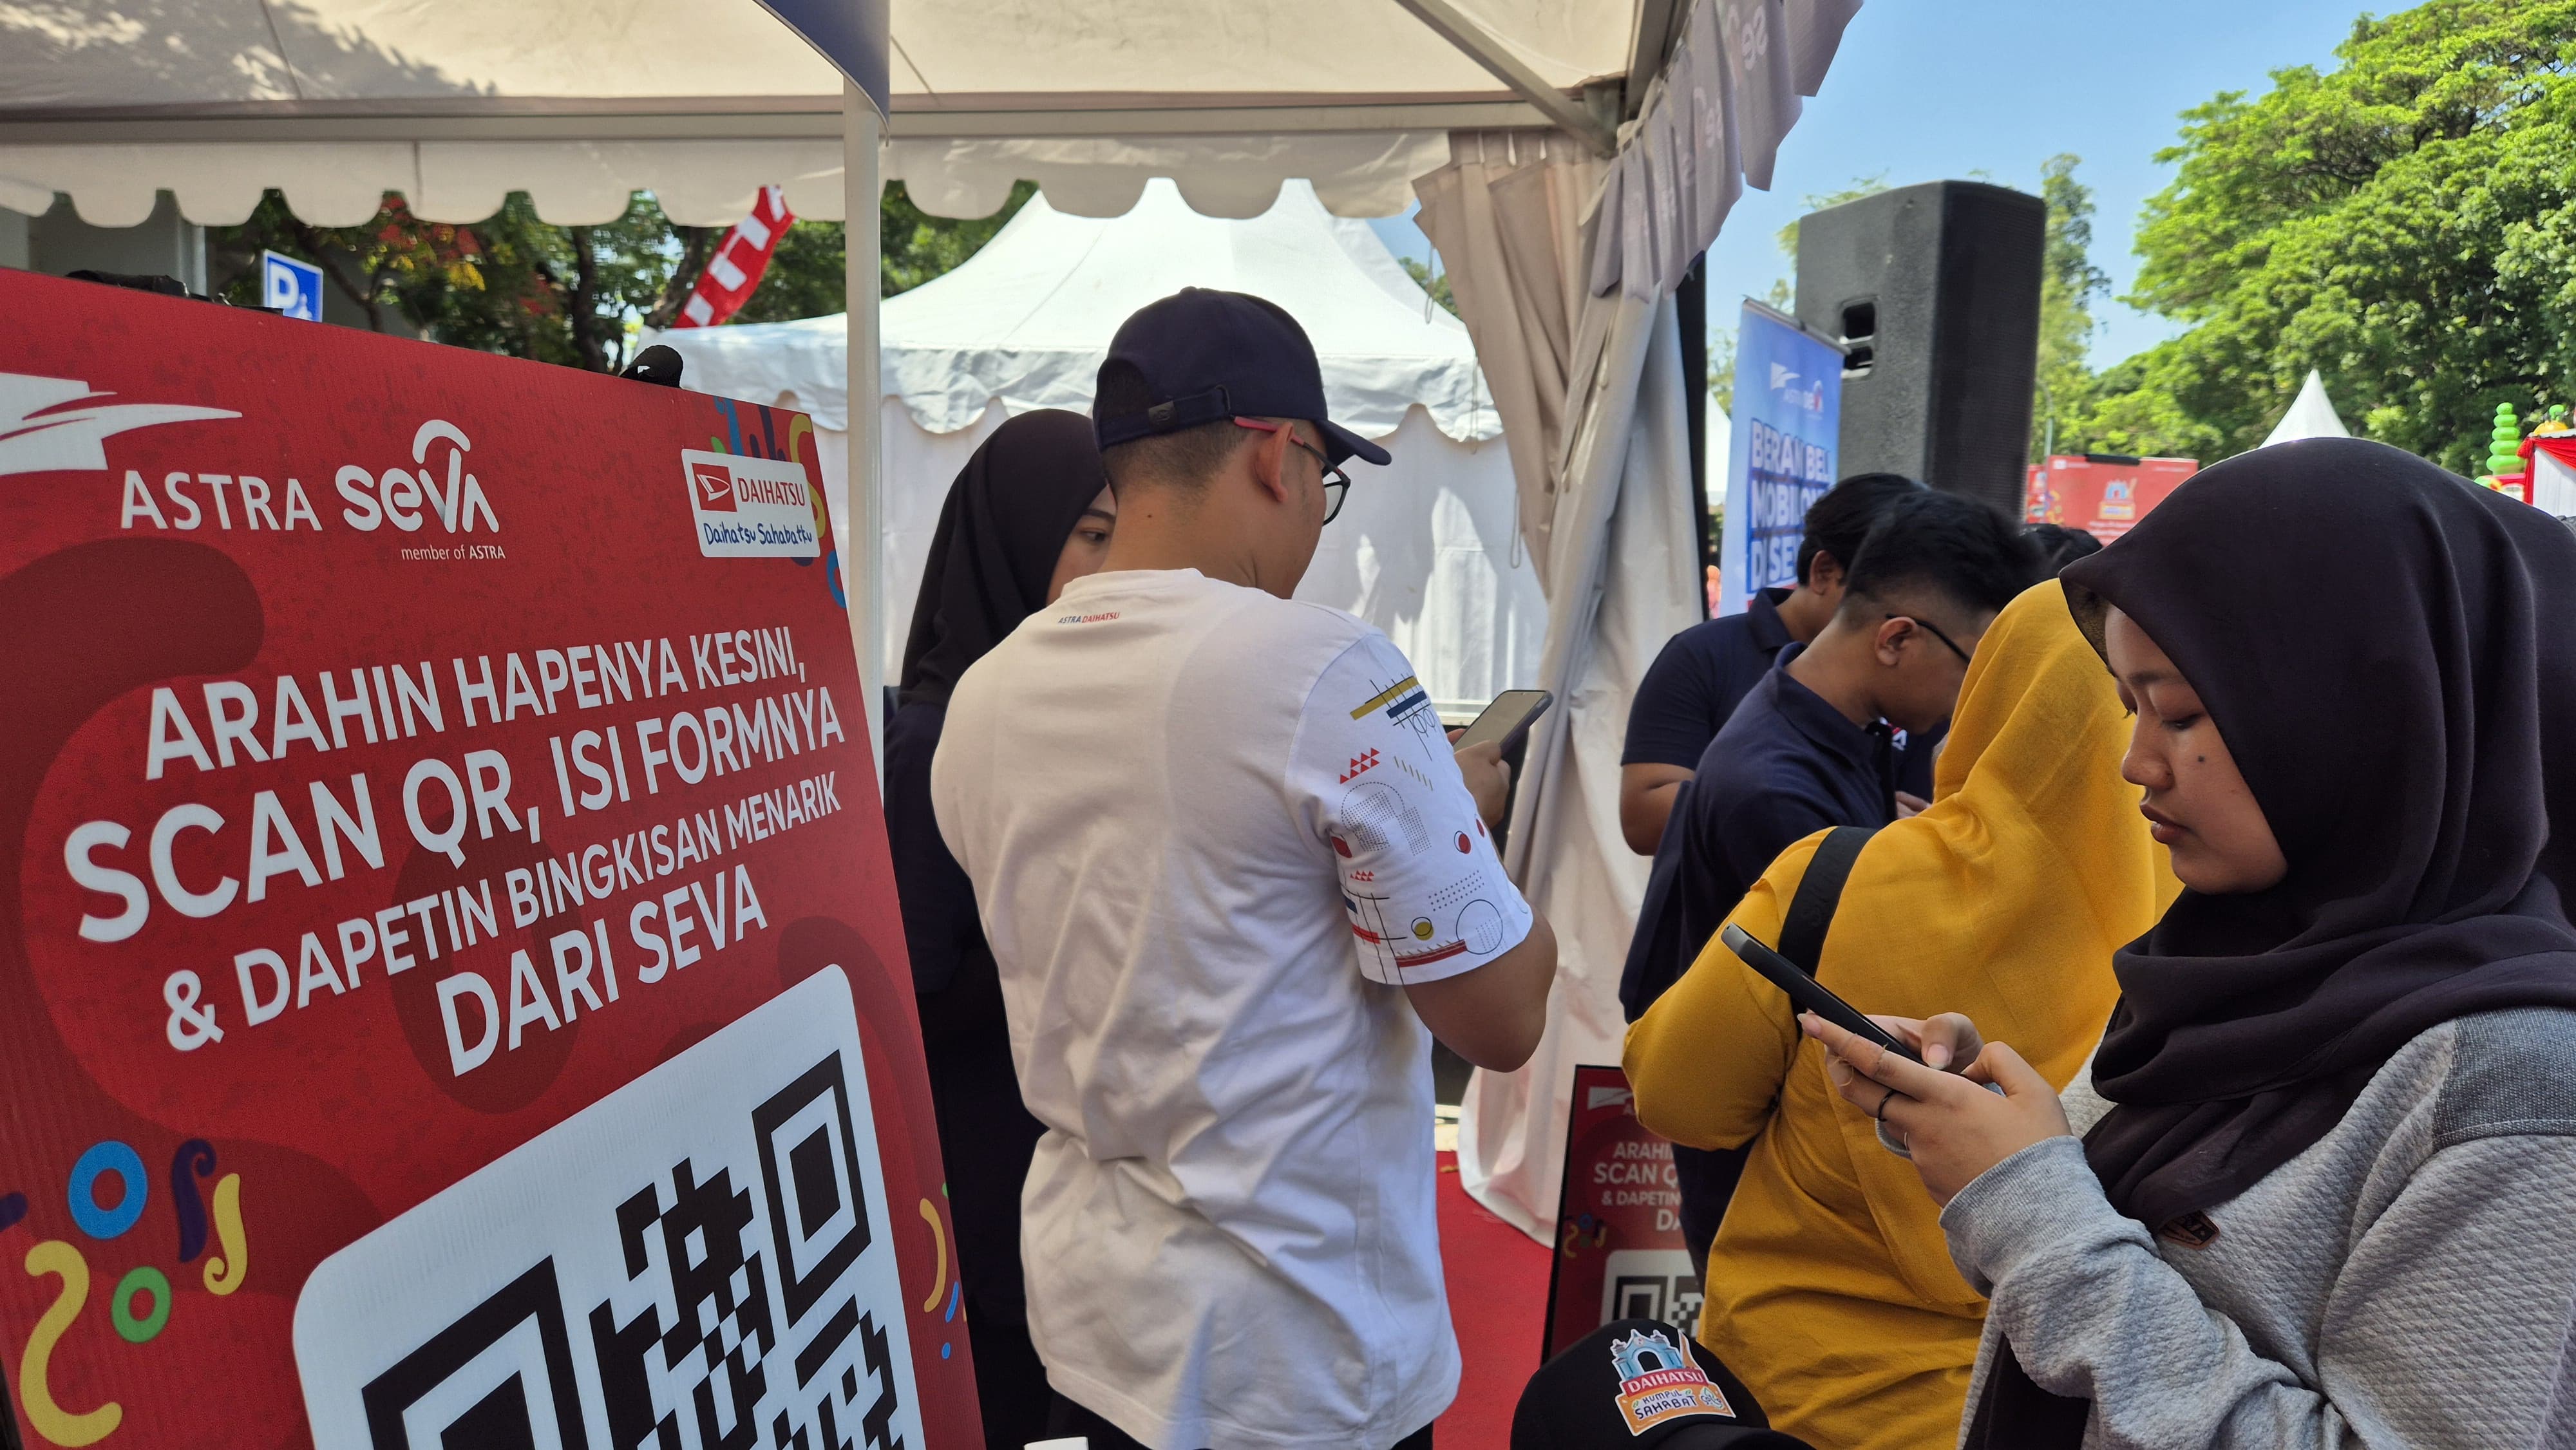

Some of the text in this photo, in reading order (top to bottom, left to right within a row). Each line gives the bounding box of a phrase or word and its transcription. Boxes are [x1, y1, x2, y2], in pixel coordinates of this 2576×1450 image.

[121, 470, 323, 531] ASTRA
[737, 477, 806, 507] DAIHATSU
[703, 522, 756, 545] Daihatsu
[401, 544, 506, 560] member of ASTRA
[146, 626, 804, 780] ARAHIN HAPENYA KESINI,
[64, 686, 846, 943] SCAN QR, ISI FORMNYA
[164, 771, 842, 1051] & DAPETIN BINGKISAN MENARIK
[435, 863, 768, 1077] DARI SEVA
[1593, 1163, 1657, 1184] SCAN
[1628, 1371, 1703, 1393] DAIHATSU
[1634, 1395, 1698, 1420] SAHABAT
